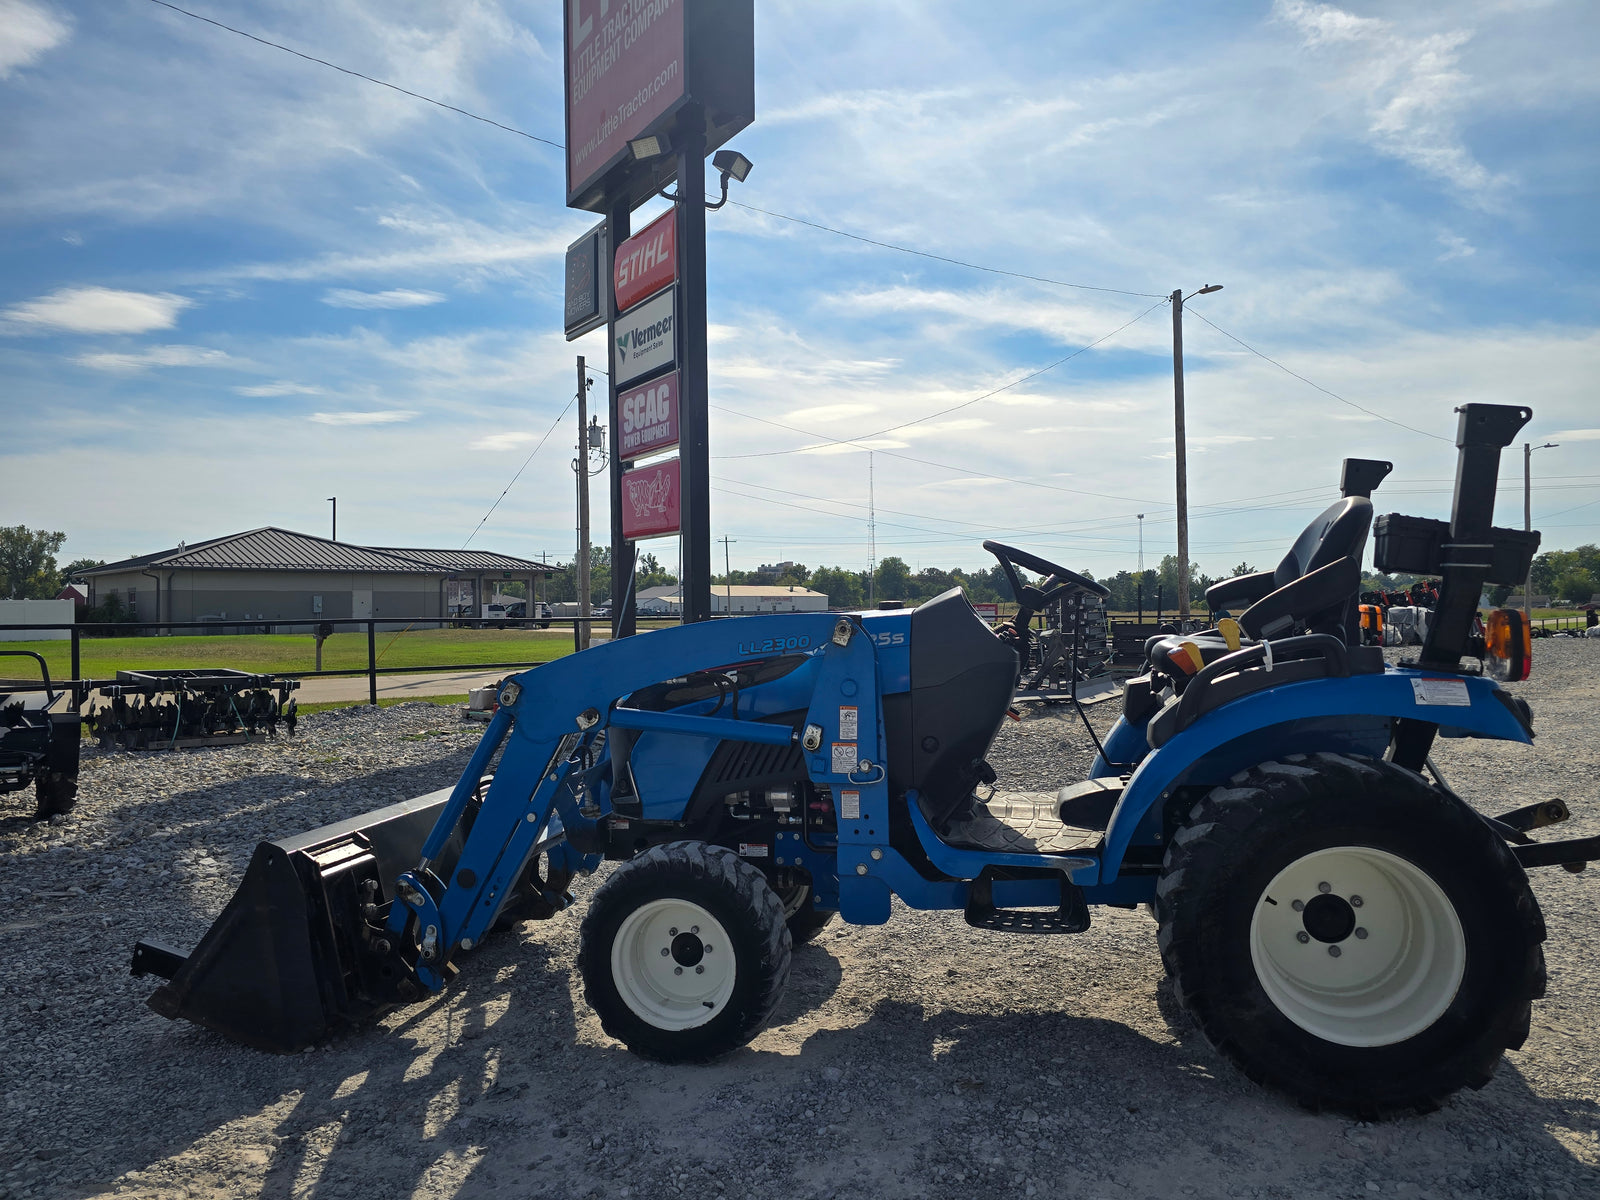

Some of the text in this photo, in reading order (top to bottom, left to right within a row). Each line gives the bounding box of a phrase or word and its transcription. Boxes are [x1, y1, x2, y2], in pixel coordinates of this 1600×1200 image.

[573, 0, 674, 105] EQUIPMENT COMPAN
[573, 34, 600, 83] LITTLE
[575, 60, 678, 166] www.LittleTractor.com
[619, 232, 669, 288] STIHL
[631, 315, 672, 349] Vermeer
[633, 344, 652, 359] Equipment
[623, 383, 670, 434] SCAG
[624, 421, 670, 449] POWER EQUIPMENT
[738, 635, 810, 655] LL2300
